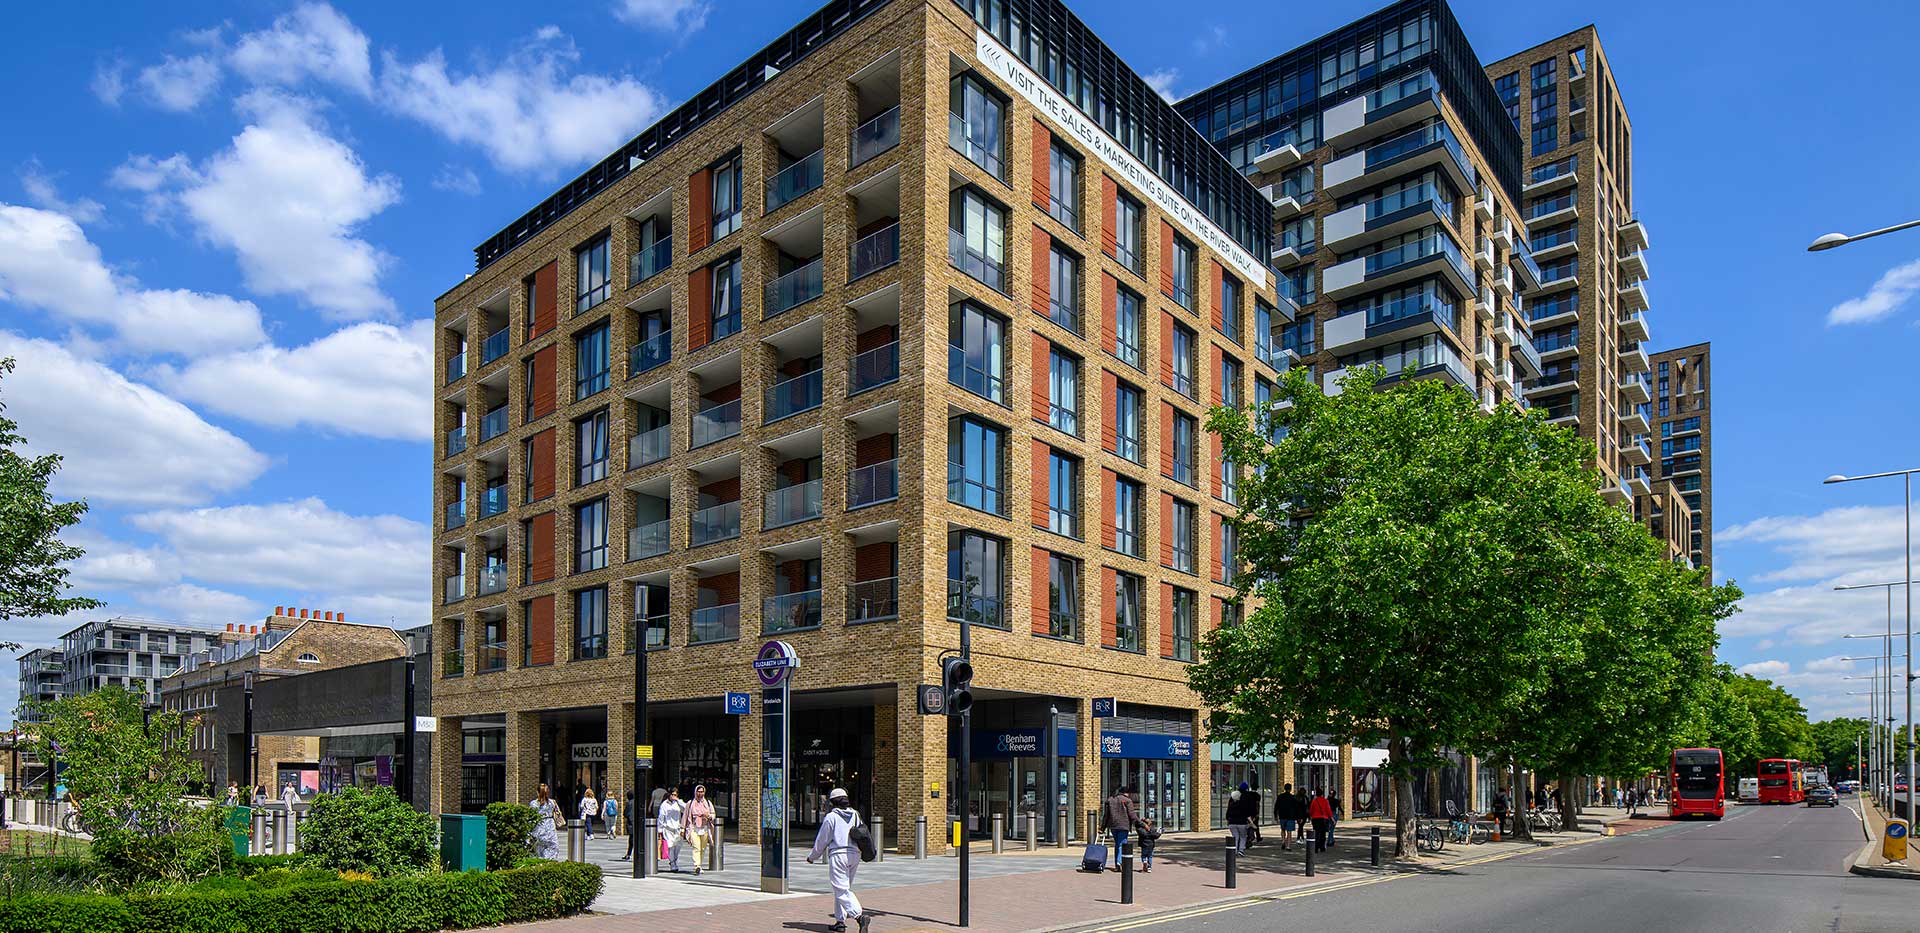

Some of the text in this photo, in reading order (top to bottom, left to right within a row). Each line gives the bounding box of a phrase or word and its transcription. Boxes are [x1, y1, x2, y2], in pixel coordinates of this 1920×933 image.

[1007, 62, 1251, 273] VISIT THE SALES & MARKETING SUITE ON THE RIVER WALK
[731, 694, 746, 708] B&R
[1095, 699, 1111, 713] B&R
[418, 720, 435, 729] M&S
[997, 735, 1036, 752] & Reeves
[1005, 734, 1036, 744] Benham
[1102, 735, 1122, 746] Lettings
[574, 747, 590, 758] M&S
[1106, 744, 1122, 753] Sales
[1307, 748, 1337, 762] OODHALL
